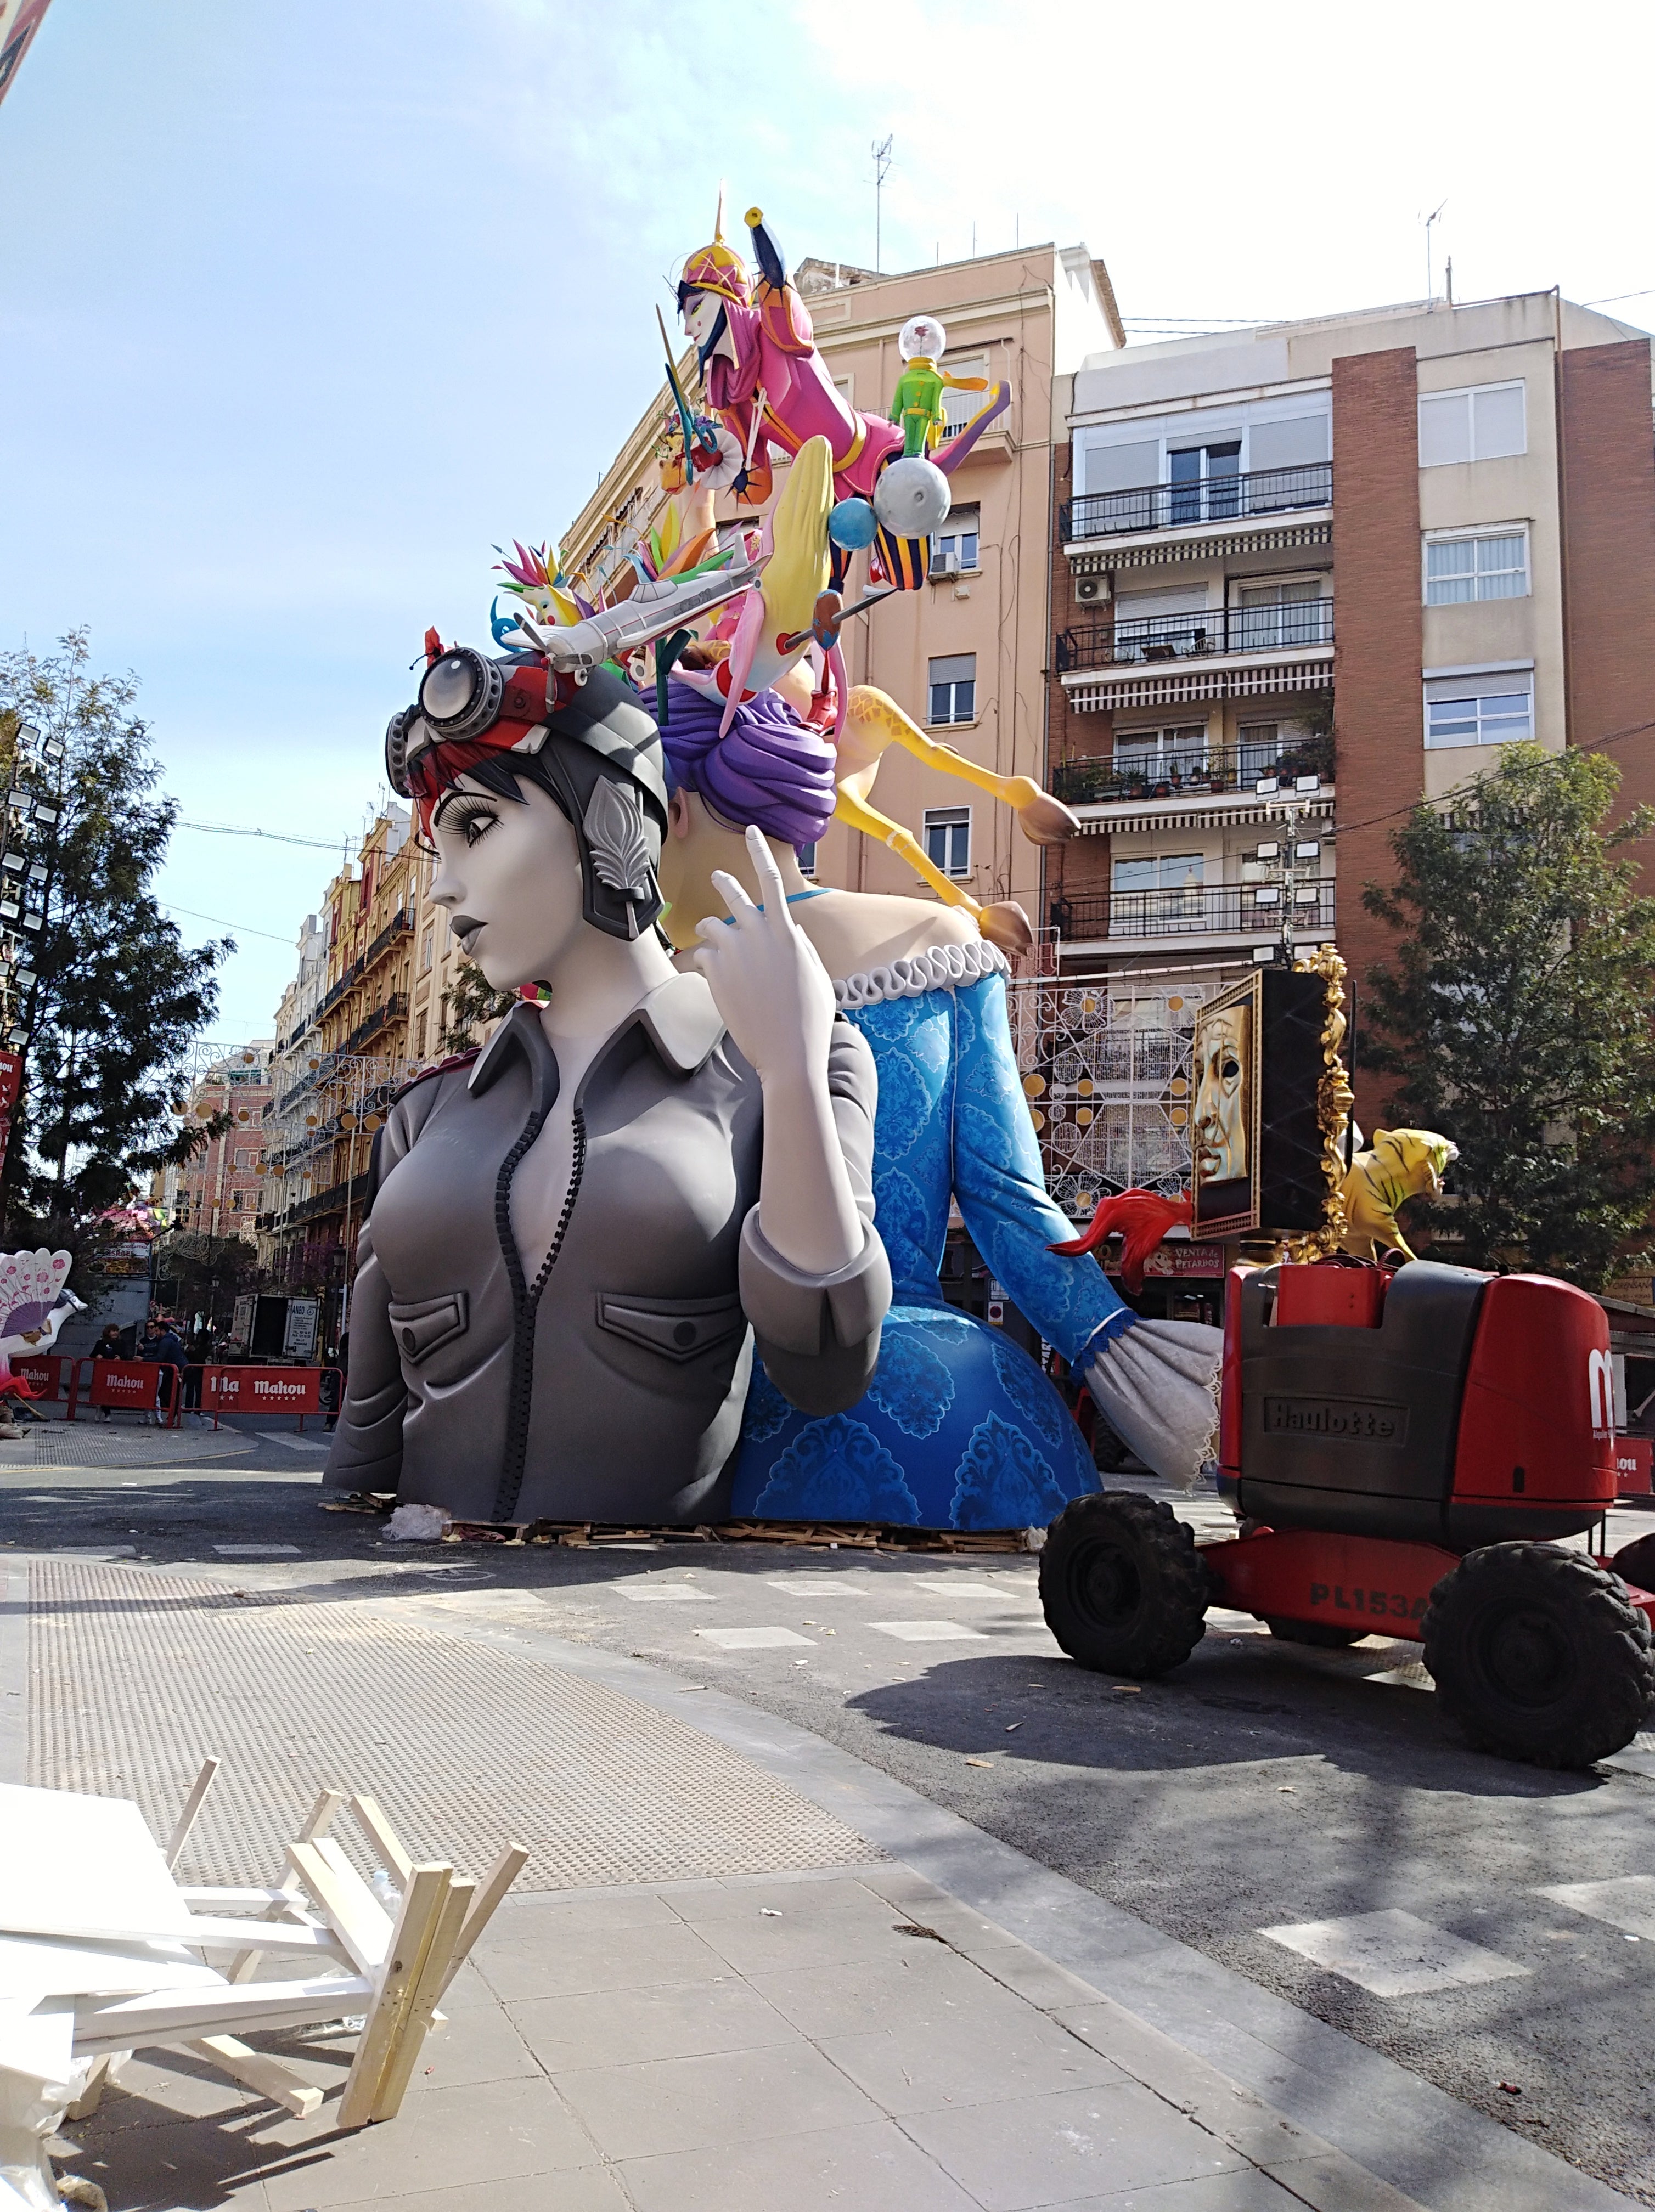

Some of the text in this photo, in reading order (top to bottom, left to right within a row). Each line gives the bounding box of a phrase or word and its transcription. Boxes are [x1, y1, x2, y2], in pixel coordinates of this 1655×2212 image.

[1175, 1248, 1208, 1257] VENTA
[1175, 1259, 1219, 1269] PETARDOS
[20, 1368, 49, 1381] Mahou
[106, 1374, 144, 1389] Mahou
[254, 1380, 306, 1395] Mahou
[1274, 1404, 1395, 1437] Haulotte
